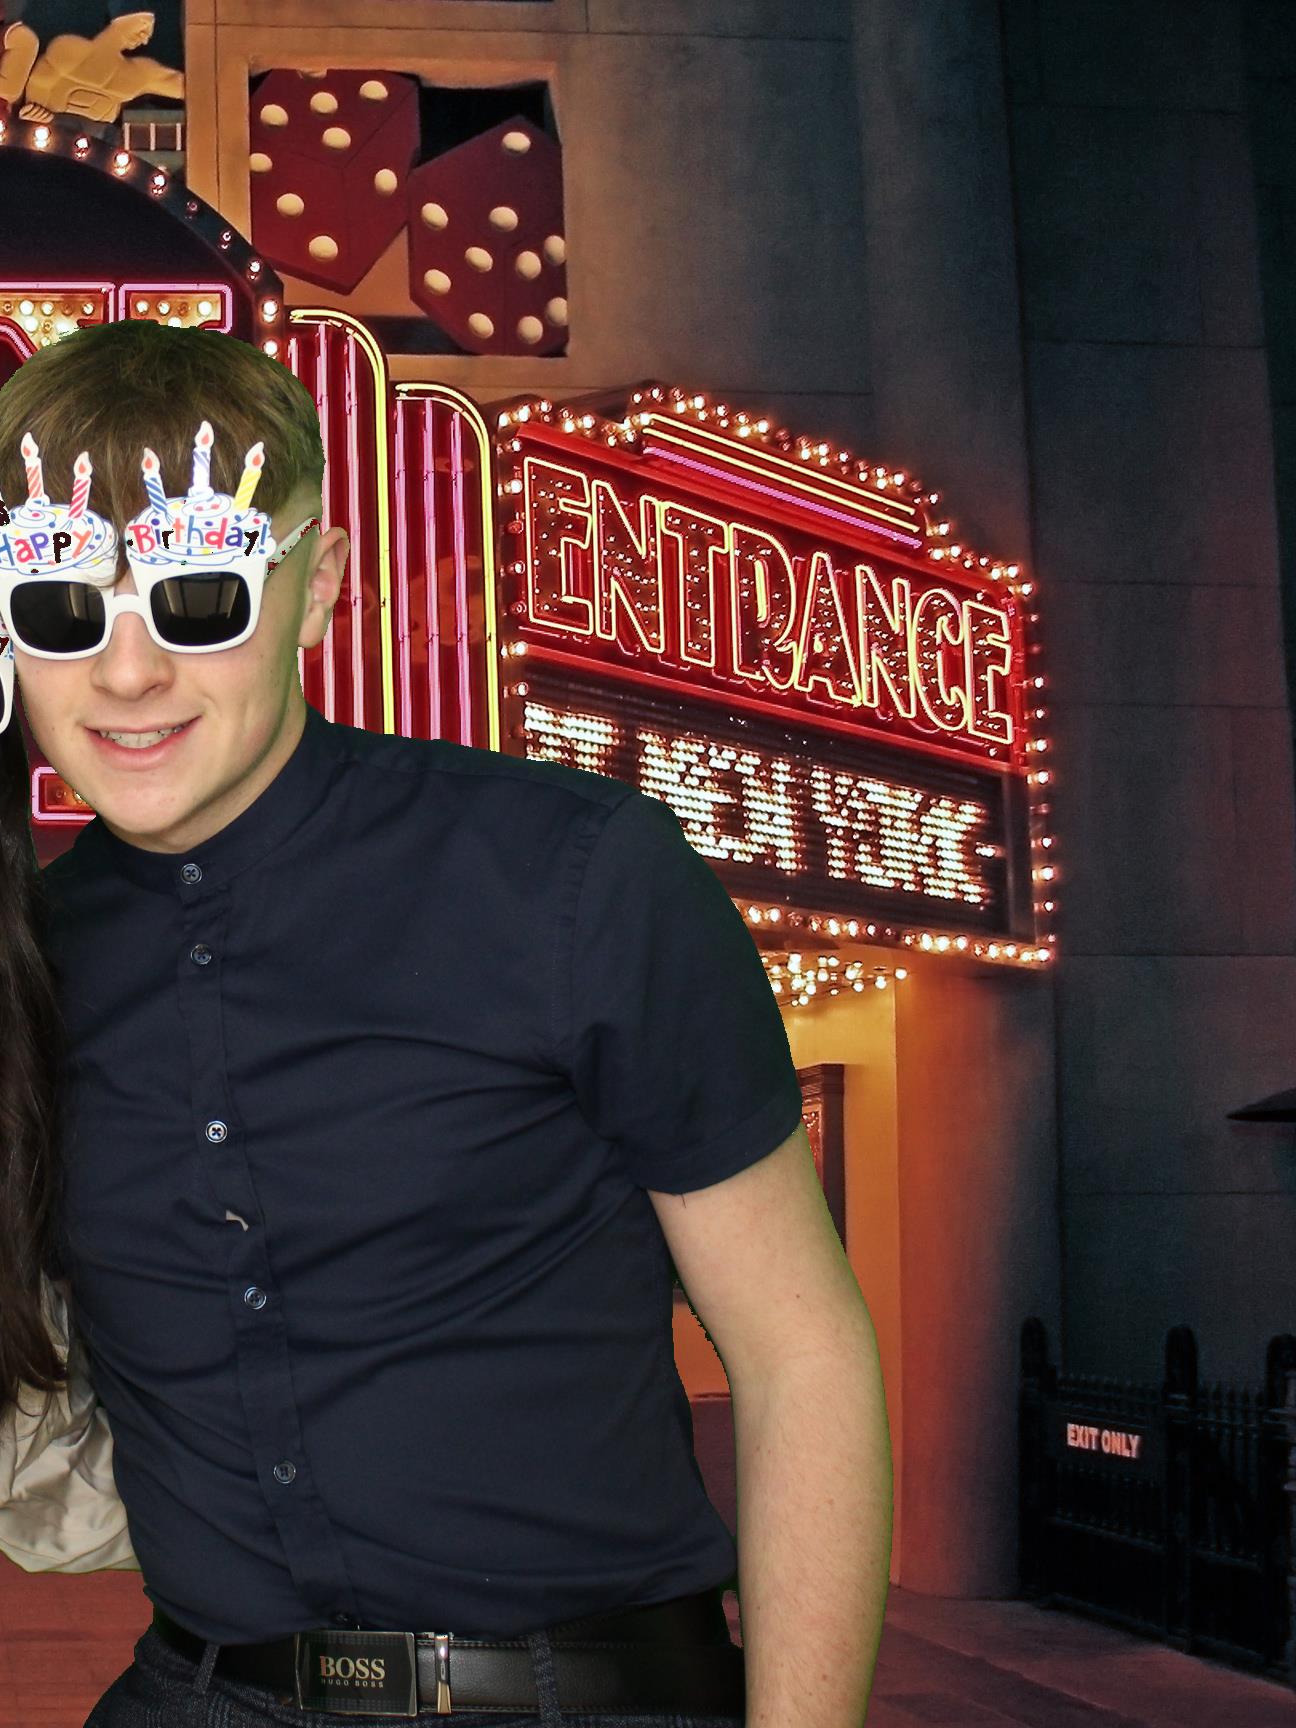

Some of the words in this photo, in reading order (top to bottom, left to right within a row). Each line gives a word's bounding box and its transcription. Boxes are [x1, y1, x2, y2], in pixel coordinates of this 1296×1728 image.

[523, 456, 1015, 745] ENTRANCE
[1067, 1423, 1099, 1450] EXIT
[1101, 1430, 1142, 1458] ONLY
[320, 1655, 385, 1679] BOSS
[321, 1678, 349, 1687] HUGO
[354, 1680, 384, 1688] BOSS
